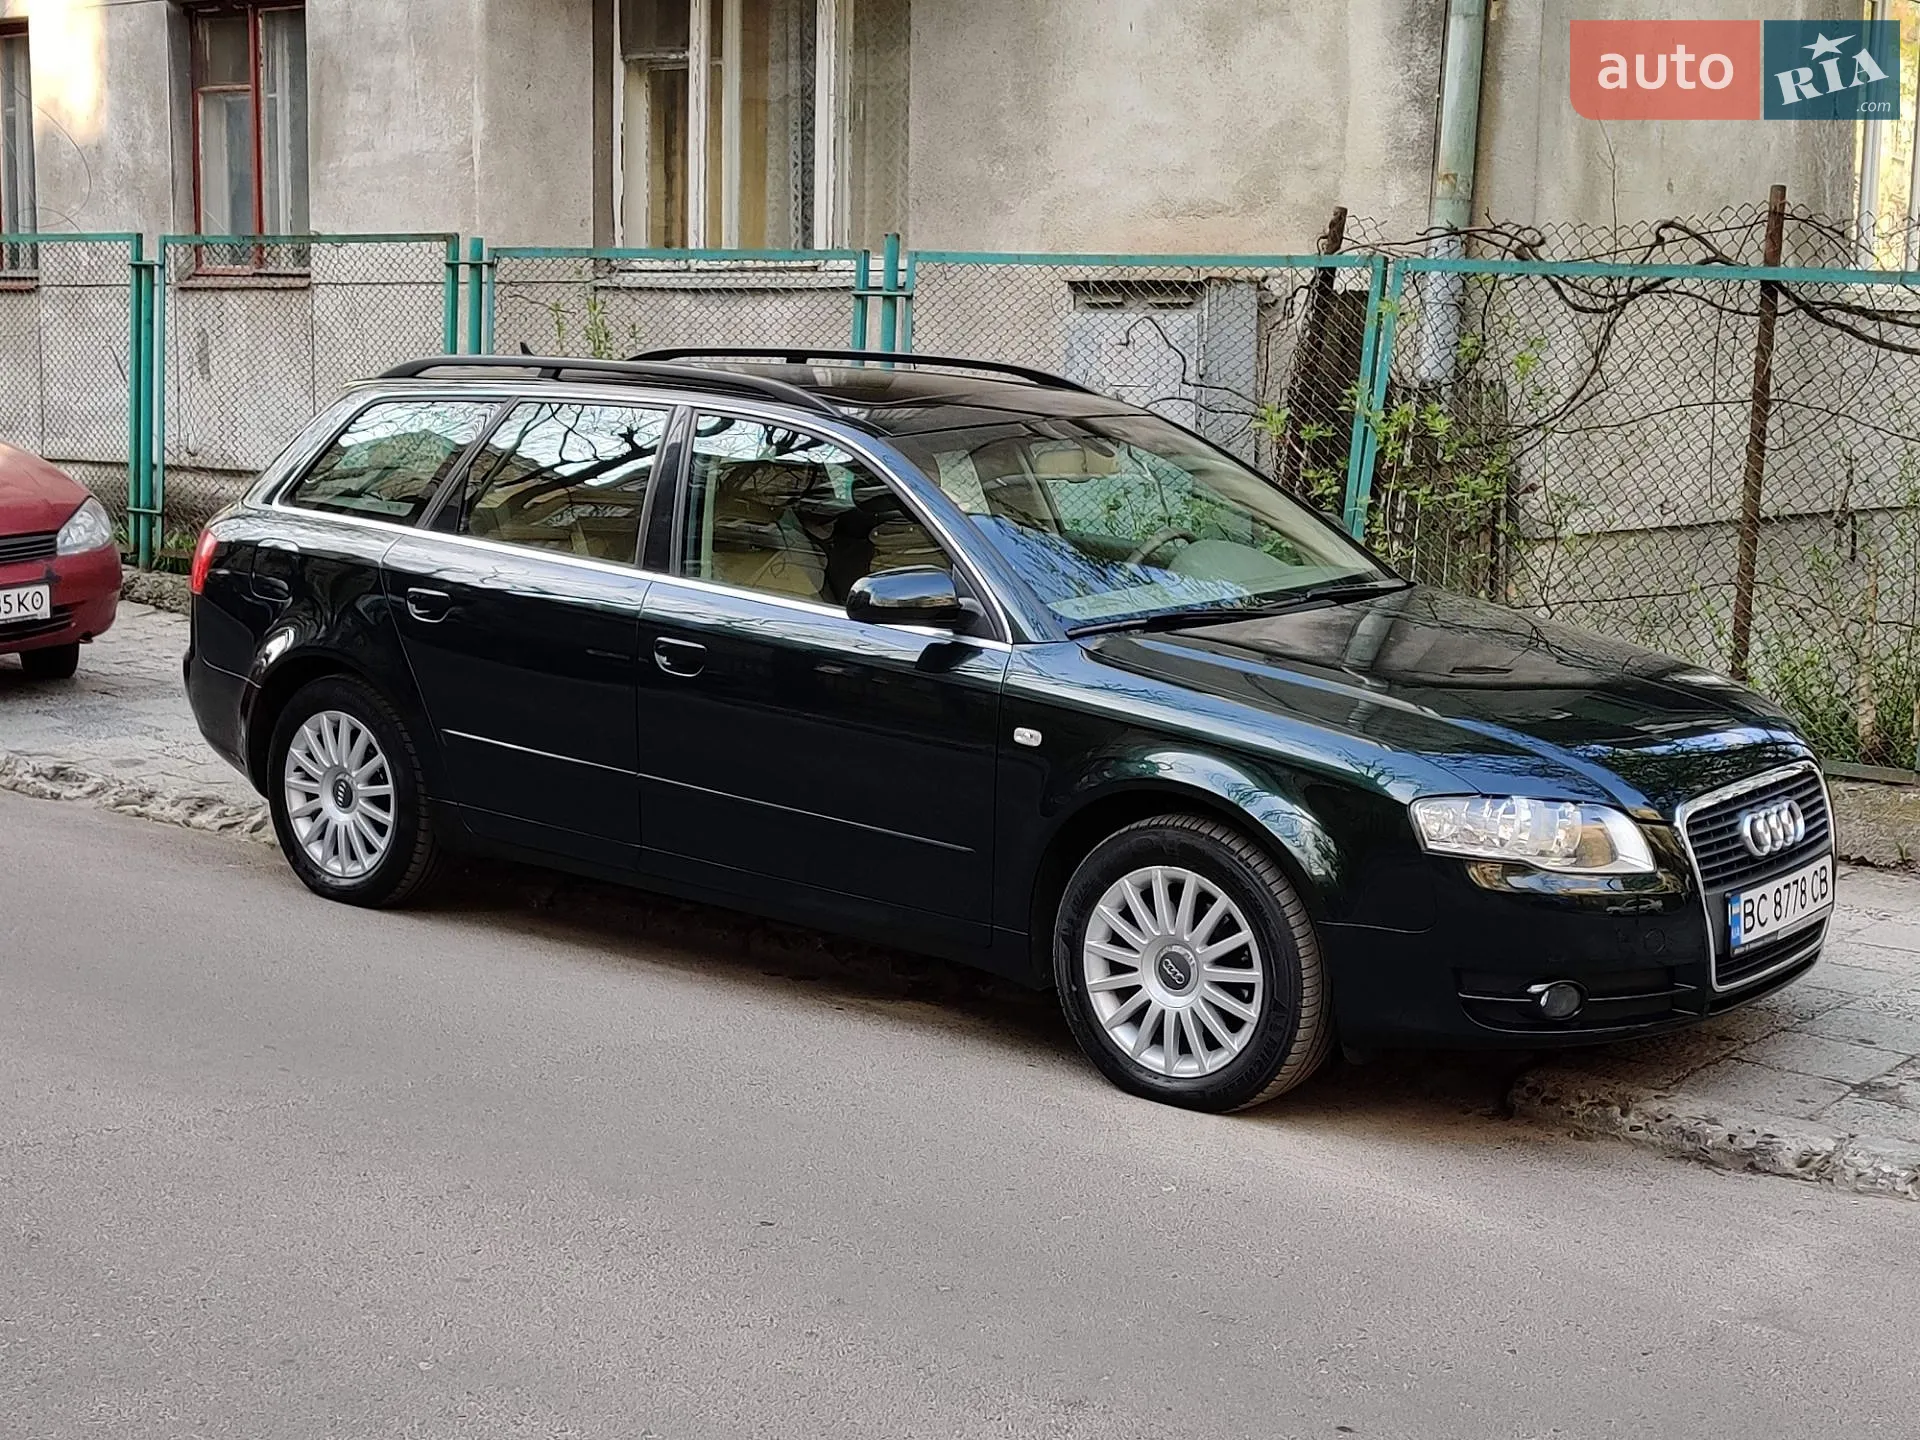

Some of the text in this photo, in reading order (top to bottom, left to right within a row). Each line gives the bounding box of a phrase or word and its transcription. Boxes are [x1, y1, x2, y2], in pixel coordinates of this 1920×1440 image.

[17, 591, 43, 612] KO
[1743, 865, 1828, 934] BC 8778 CB
